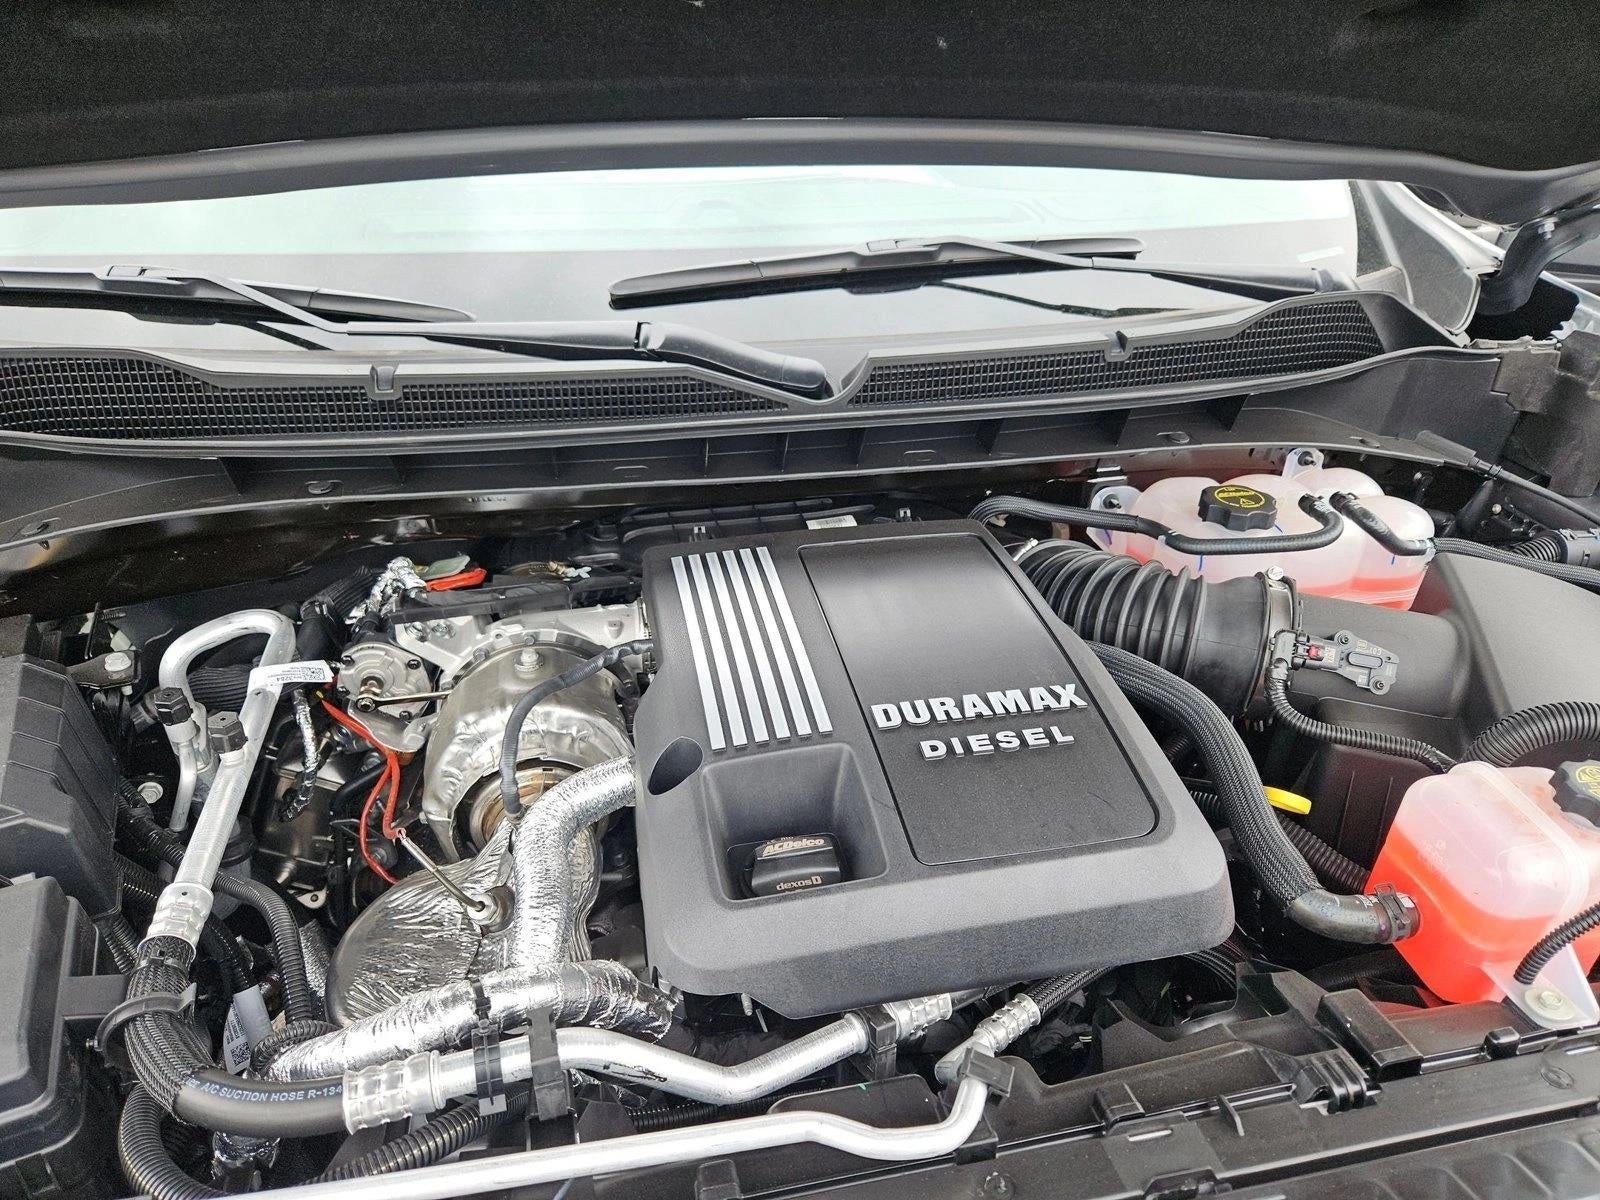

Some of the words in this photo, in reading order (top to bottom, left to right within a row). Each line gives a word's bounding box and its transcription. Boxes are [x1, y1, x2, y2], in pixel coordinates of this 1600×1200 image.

[870, 683, 1088, 731] DURAMAX
[918, 726, 1075, 761] DIESEL
[763, 838, 825, 857] ACDelco
[201, 1082, 220, 1095] A/C
[218, 1088, 268, 1102] SUCTION
[270, 1091, 304, 1102] HOSE
